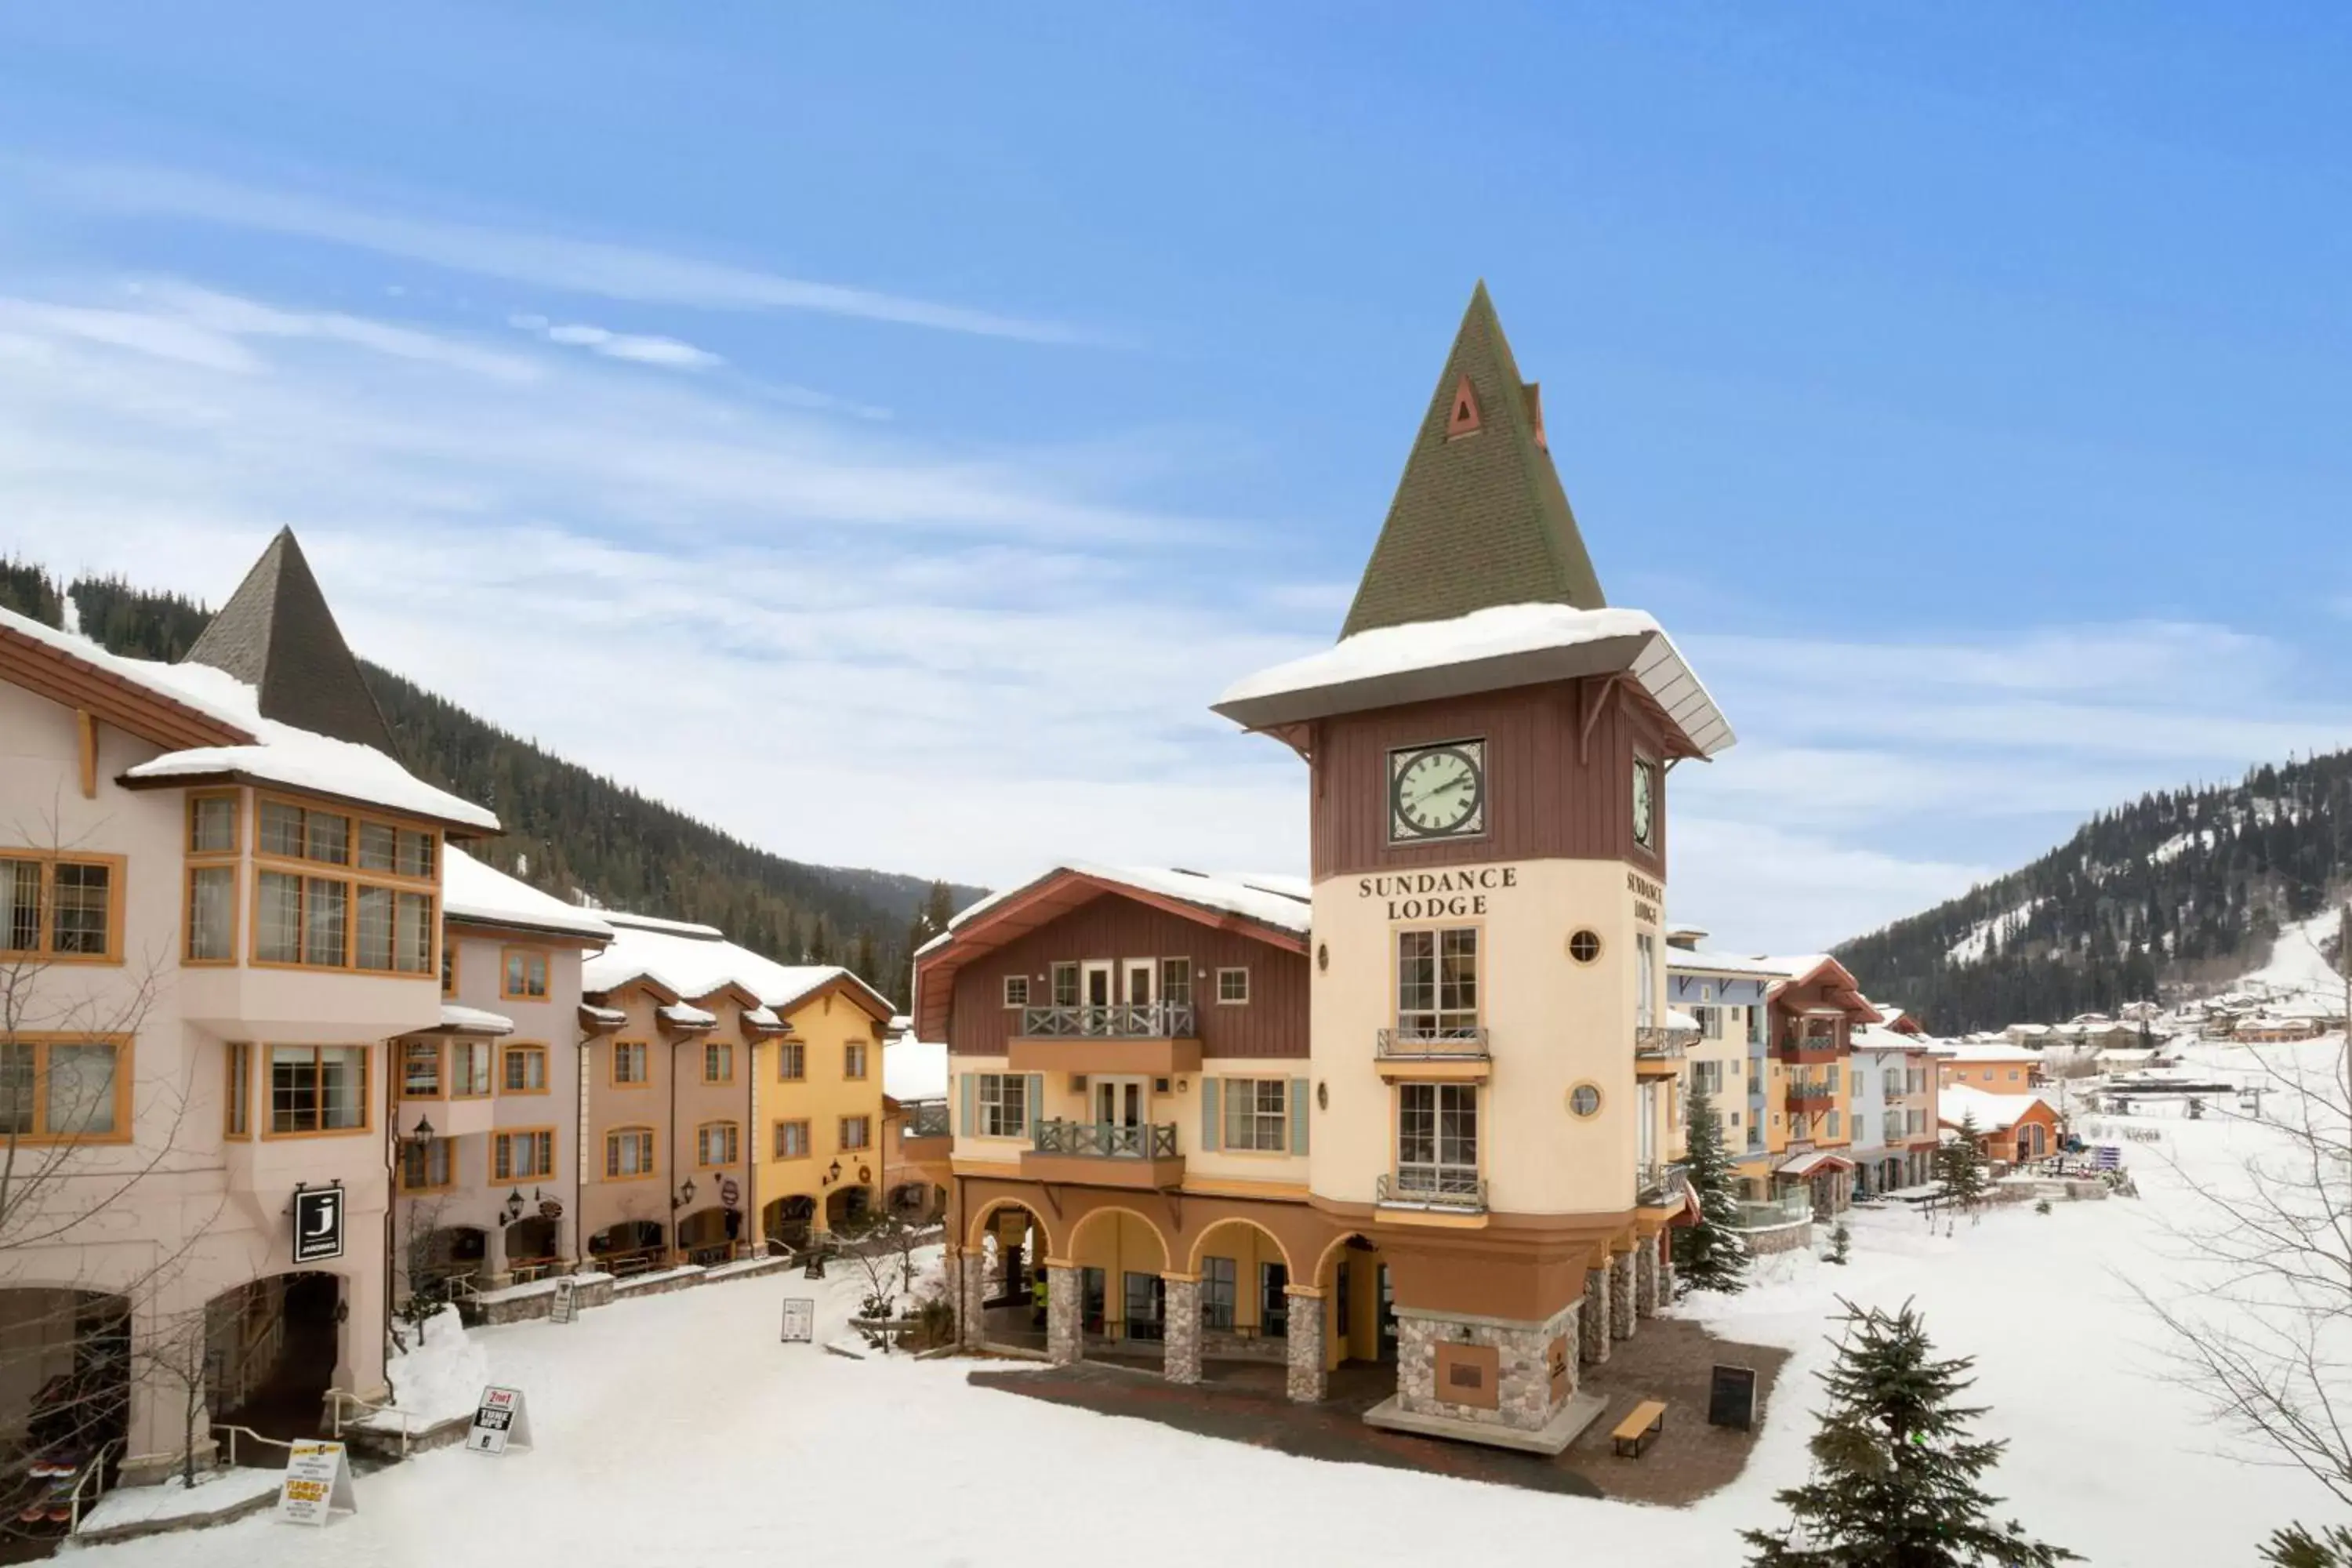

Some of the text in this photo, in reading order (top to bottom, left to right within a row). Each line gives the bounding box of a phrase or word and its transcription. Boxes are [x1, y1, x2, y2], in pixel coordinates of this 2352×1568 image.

[1359, 867, 1517, 898] SUNDANCE
[1627, 871, 1662, 906] SUNDANCE
[1388, 895, 1487, 920] LODGE
[1635, 899, 1657, 925] LODGE
